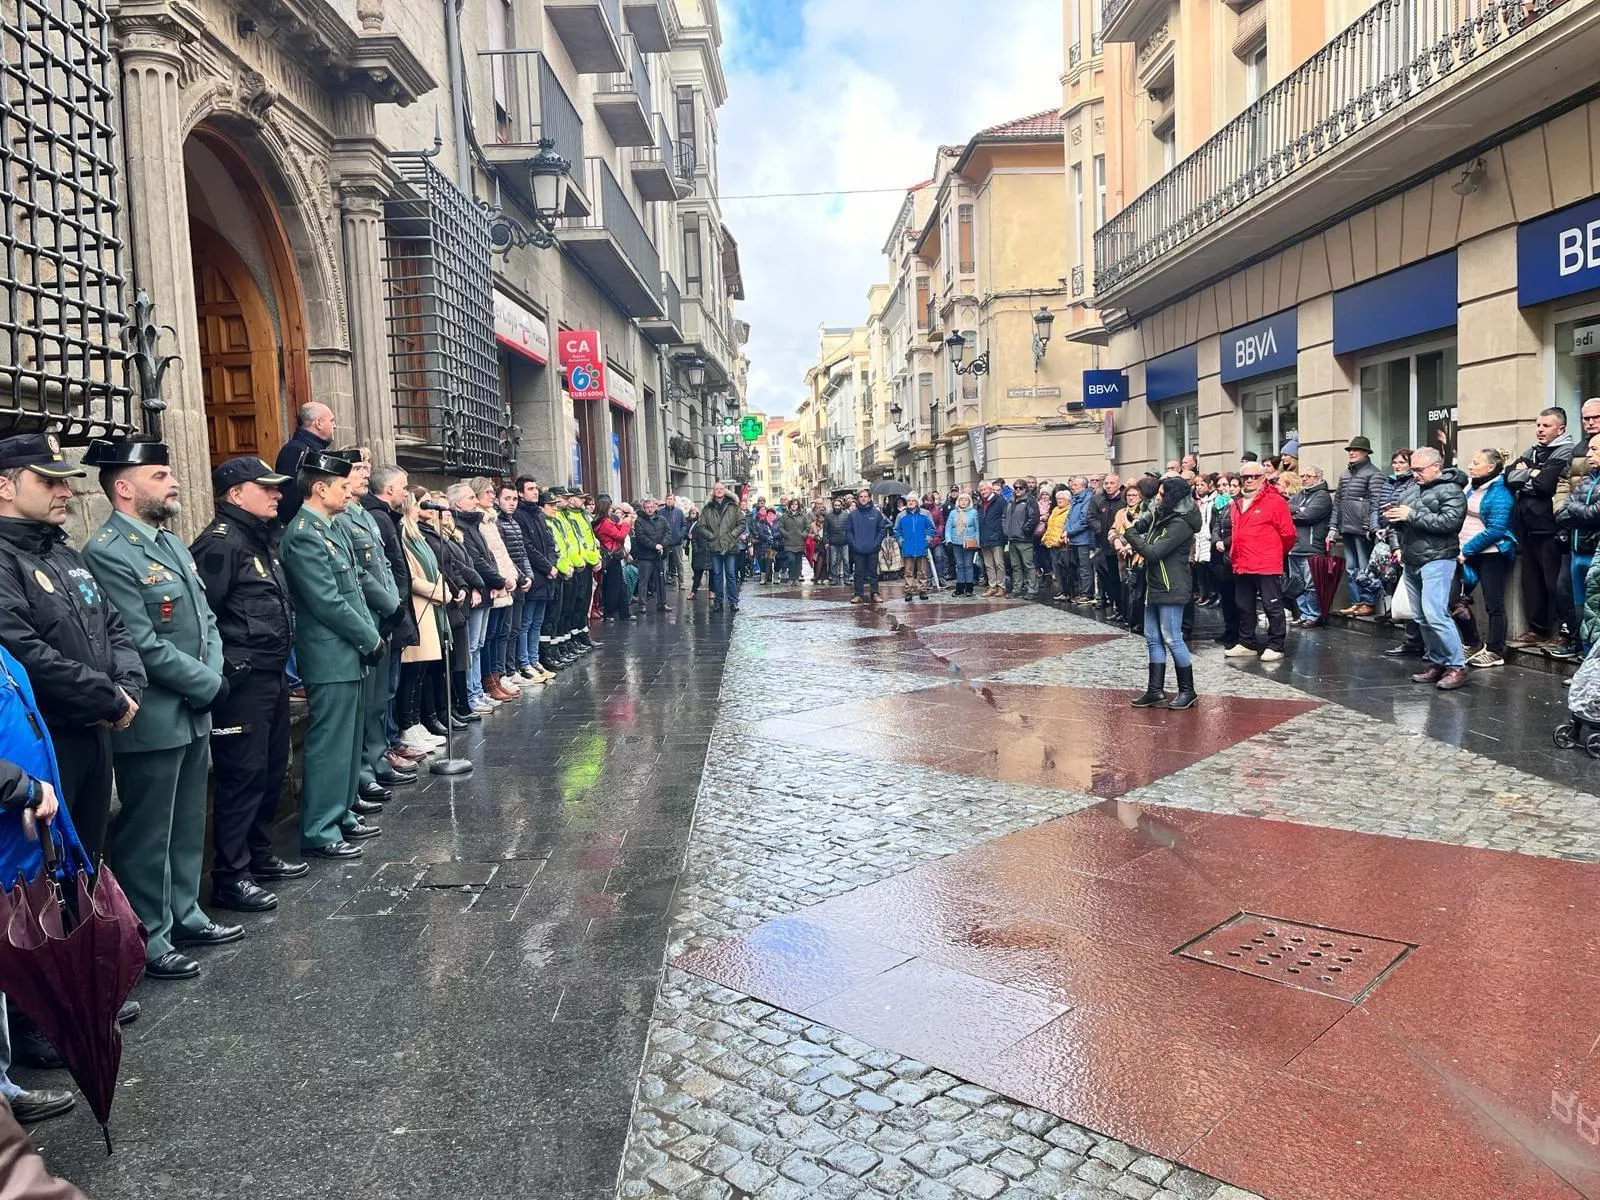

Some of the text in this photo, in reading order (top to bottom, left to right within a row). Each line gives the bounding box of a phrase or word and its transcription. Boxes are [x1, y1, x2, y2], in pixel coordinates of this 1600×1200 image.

[566, 340, 591, 353] CA
[1235, 326, 1278, 368] BBVA
[1088, 384, 1119, 395] BBVA
[1428, 408, 1449, 421] BBVA
